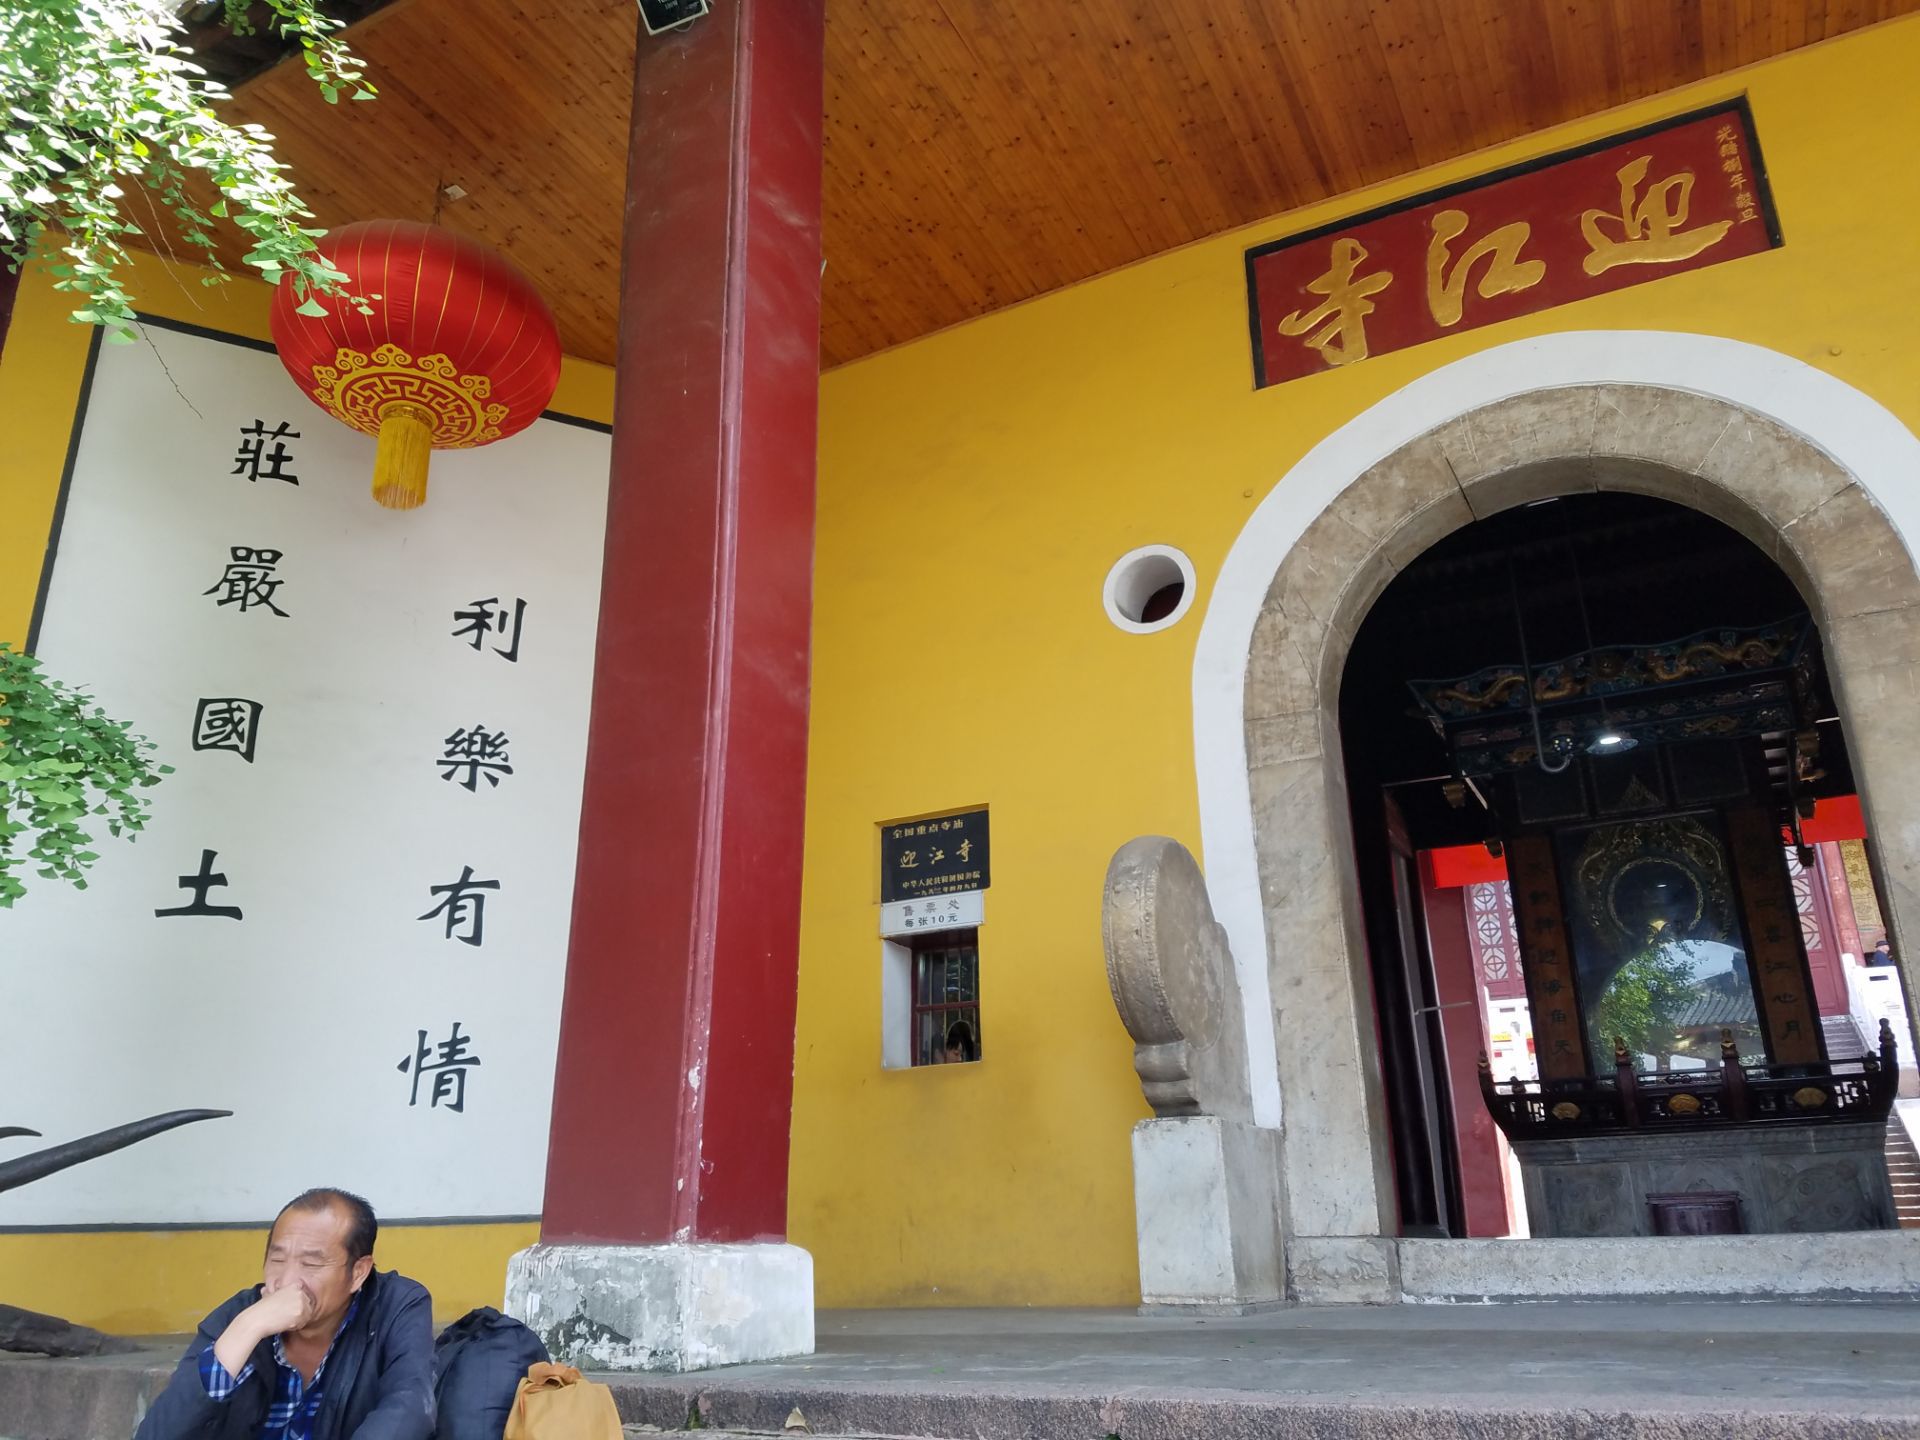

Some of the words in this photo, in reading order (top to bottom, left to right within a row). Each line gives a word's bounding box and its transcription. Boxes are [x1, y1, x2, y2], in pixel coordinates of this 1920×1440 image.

[1278, 155, 1735, 366] 迎江寺
[154, 418, 301, 921] 莊嚴國土
[397, 597, 529, 1113] 利樂有情
[893, 819, 964, 839] 全国重点寺庙
[899, 839, 973, 868] 迎江寺
[903, 899, 960, 917] 售票处
